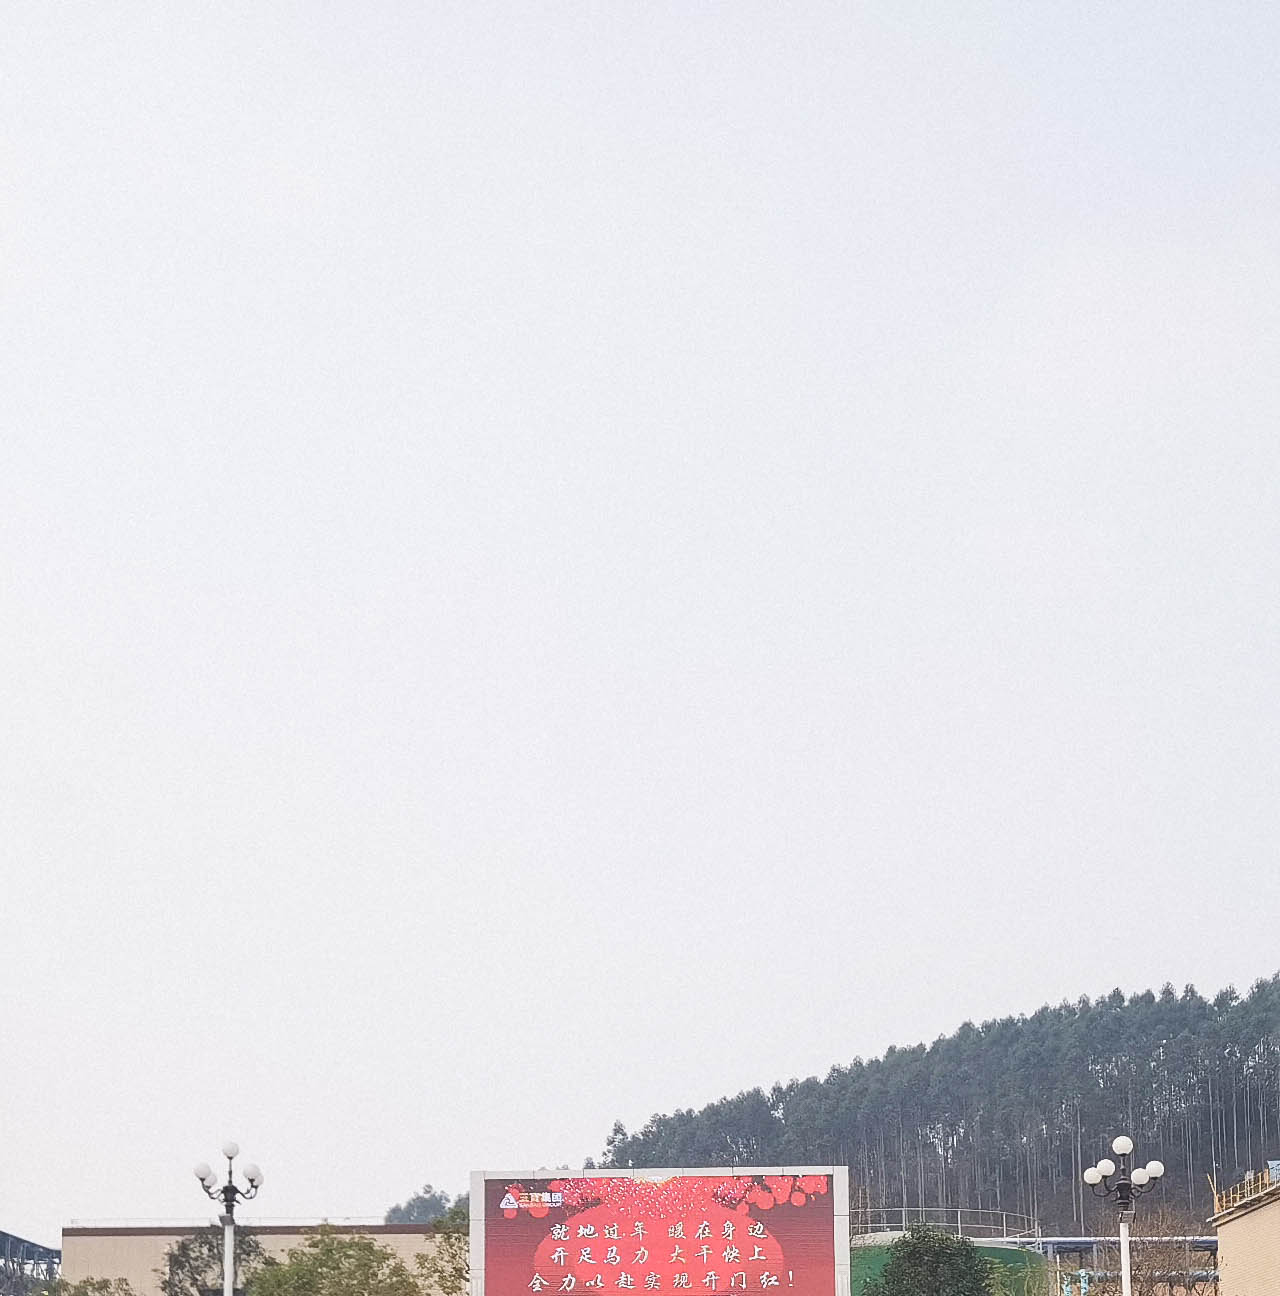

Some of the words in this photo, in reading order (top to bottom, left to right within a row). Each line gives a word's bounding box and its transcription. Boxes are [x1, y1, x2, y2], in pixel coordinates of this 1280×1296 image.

[550, 1222, 649, 1241] 就地过年
[667, 1220, 768, 1240] 暖在身边
[550, 1247, 649, 1266] 开足马力
[668, 1244, 767, 1264] 大干快上
